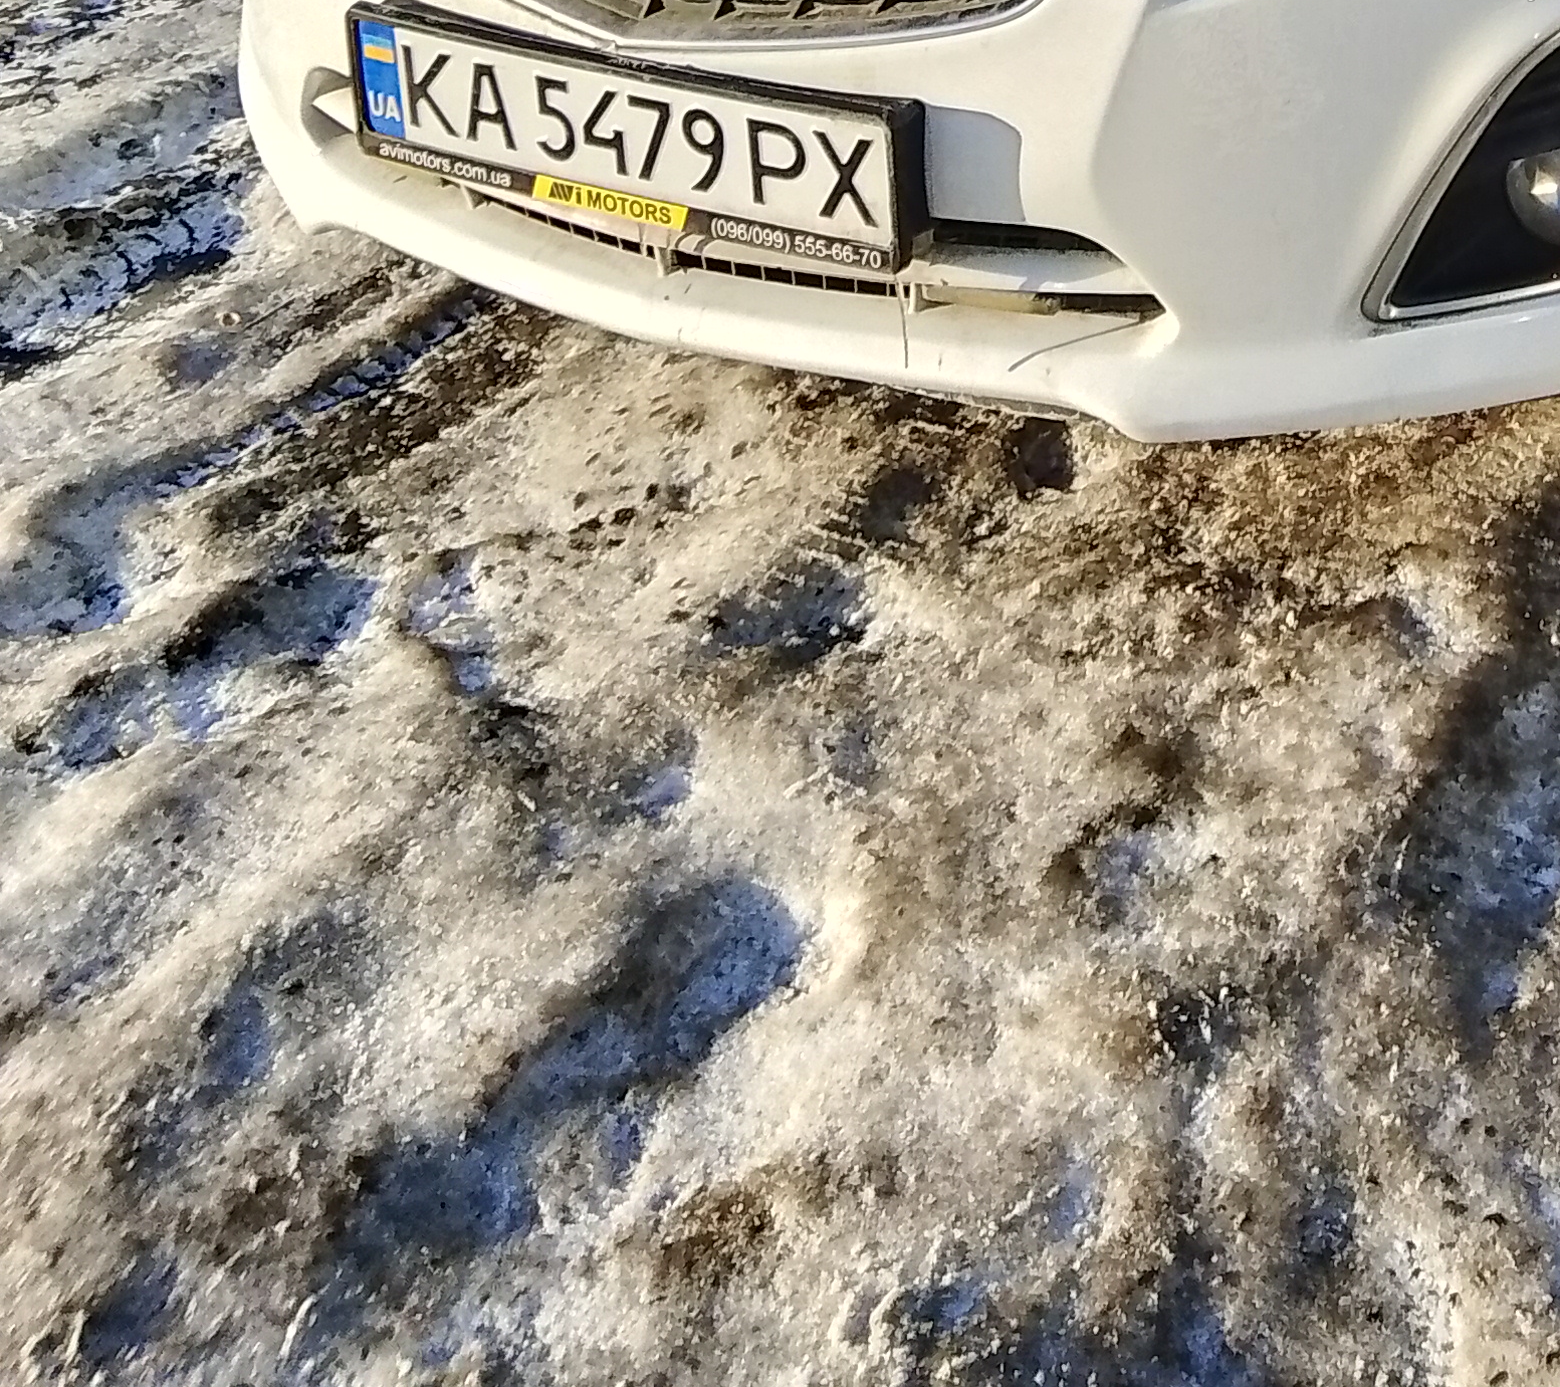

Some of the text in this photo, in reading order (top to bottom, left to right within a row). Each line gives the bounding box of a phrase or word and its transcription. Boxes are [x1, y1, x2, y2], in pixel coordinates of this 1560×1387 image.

[368, 91, 401, 122] UA
[402, 44, 879, 228] KA 5479 PX
[379, 141, 512, 189] avimotors.com.ua
[586, 188, 673, 226] MOTORS
[711, 216, 882, 270] (096/099) 555-66-70
